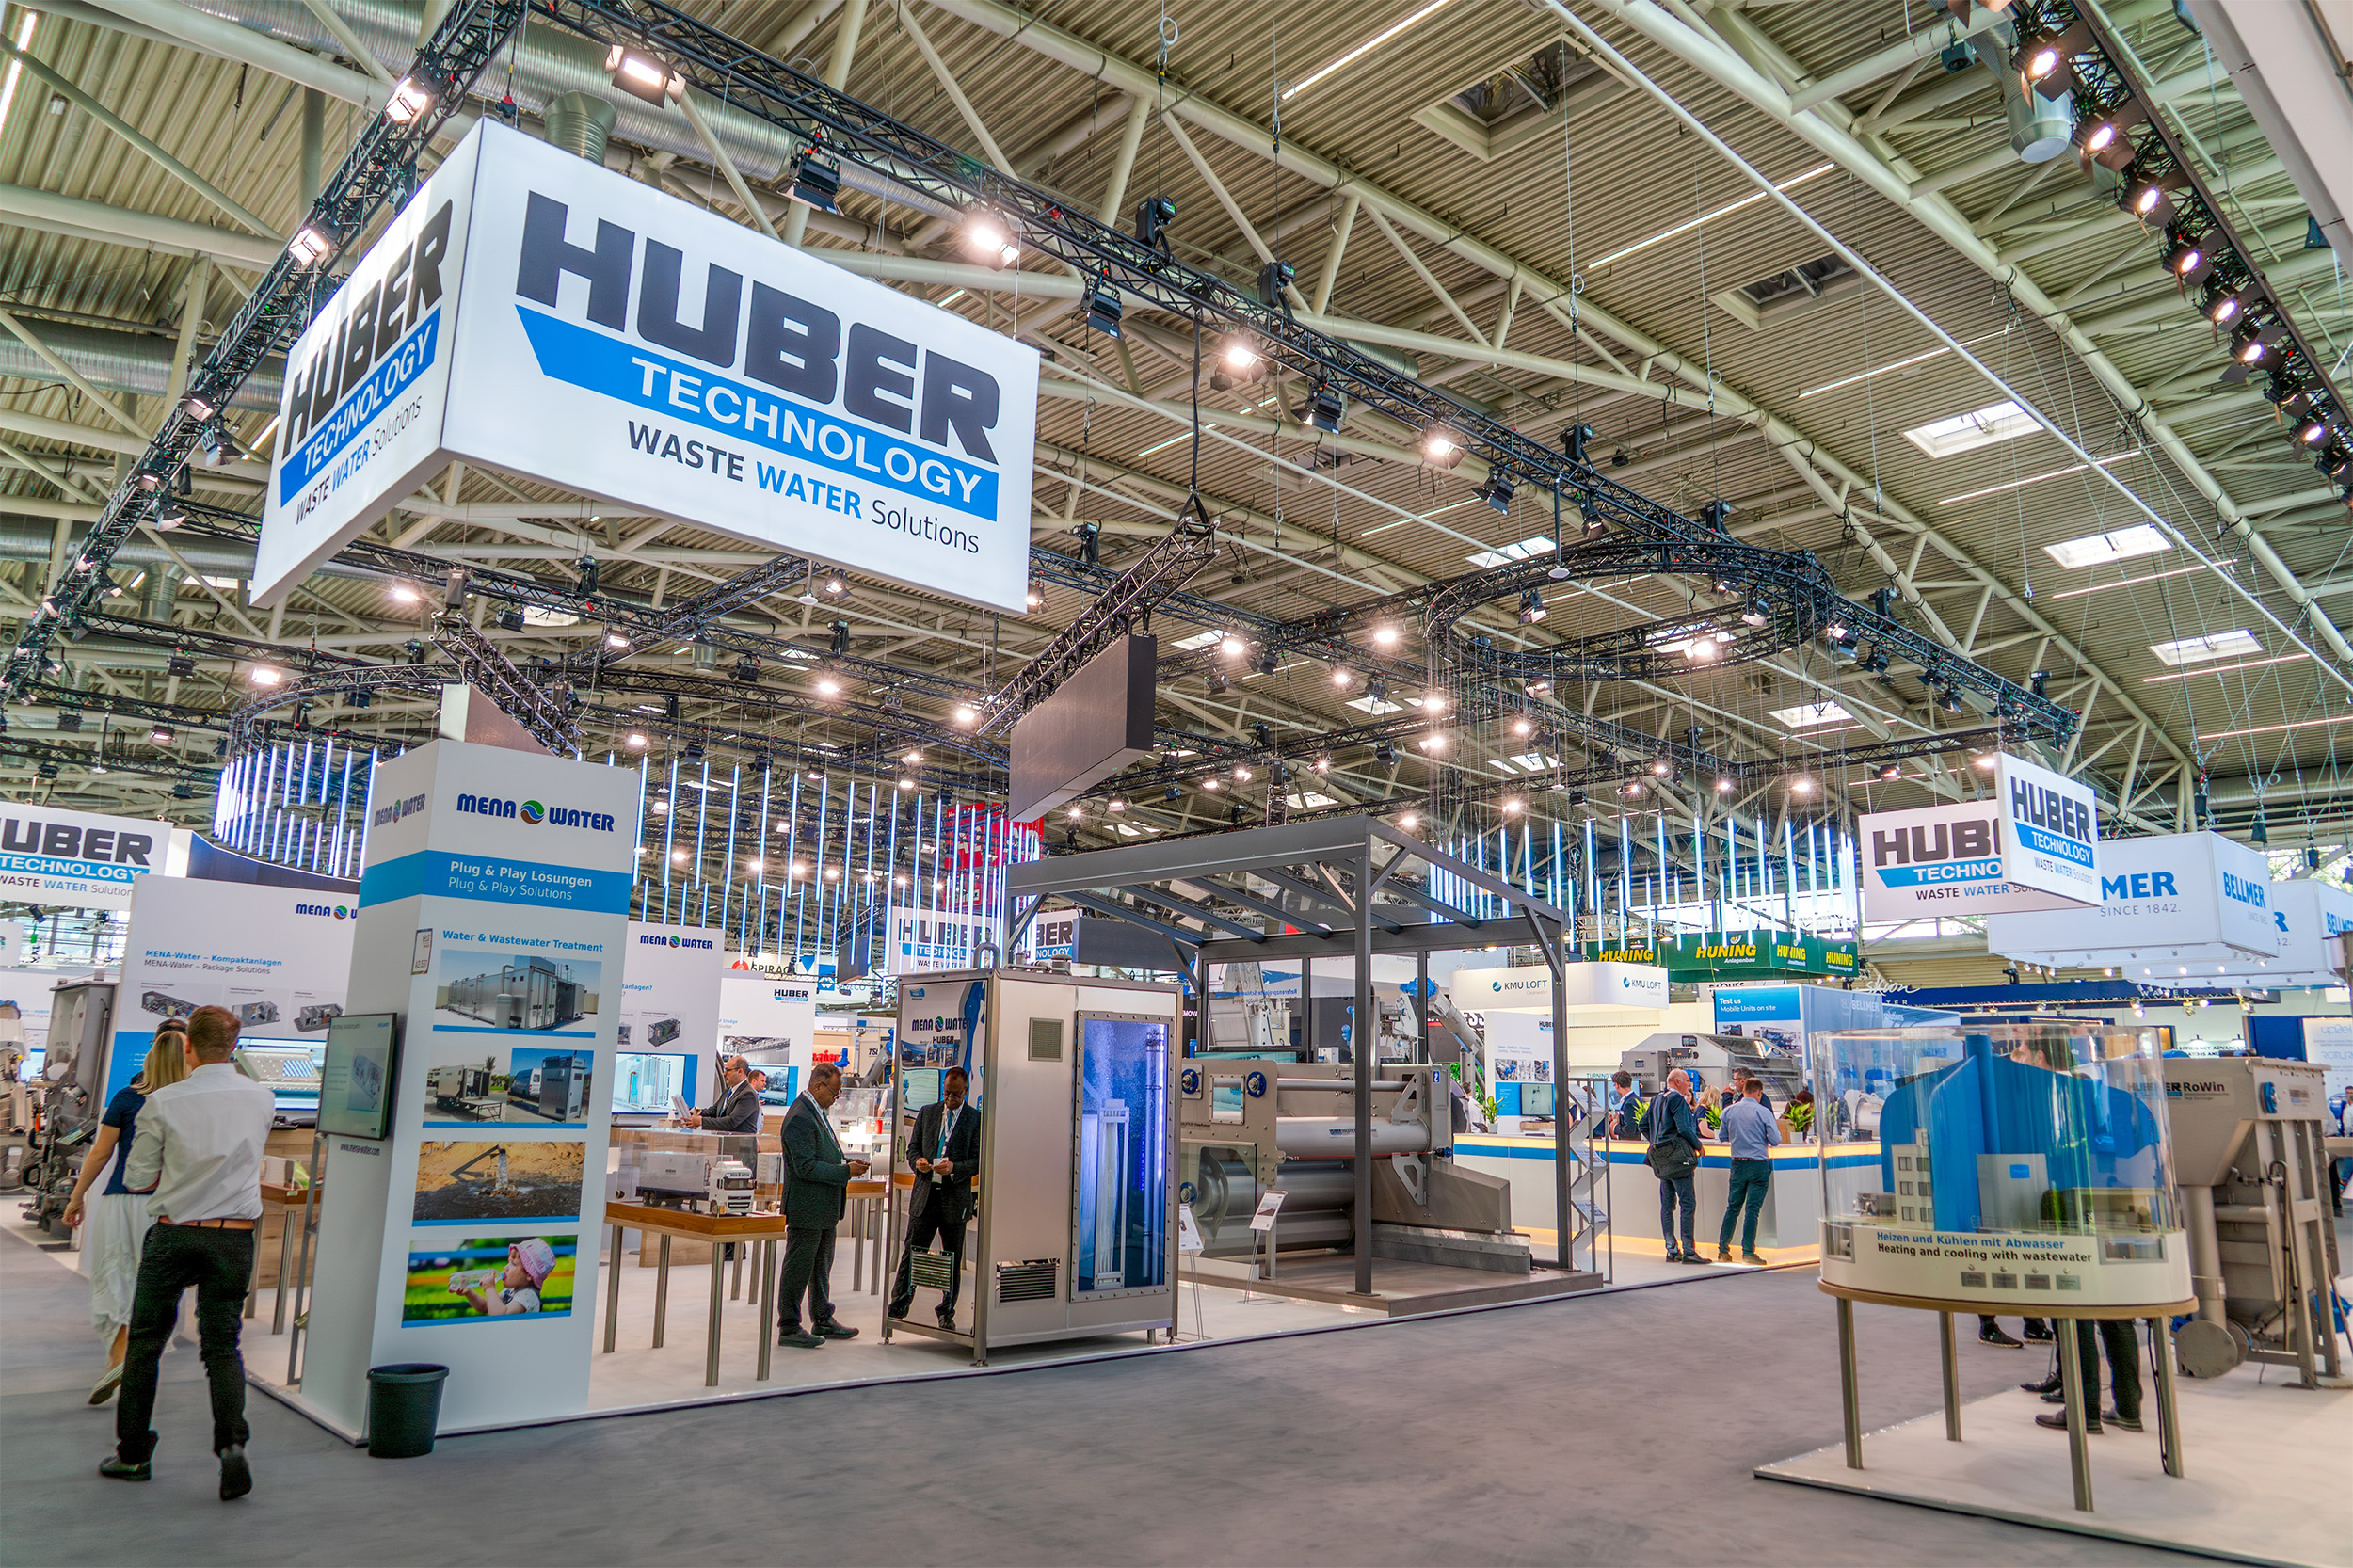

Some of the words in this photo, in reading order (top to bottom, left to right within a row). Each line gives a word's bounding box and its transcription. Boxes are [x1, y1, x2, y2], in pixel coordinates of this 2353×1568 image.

[282, 199, 453, 460] HUBER
[515, 190, 1000, 465] HUBER
[304, 325, 432, 476] TECHNOLOGY
[632, 357, 981, 502] TECHNOLOGY
[296, 480, 328, 525] WASTE
[332, 444, 369, 491] WATER
[372, 393, 422, 457] Solutions
[628, 420, 744, 482] WASTE
[757, 461, 862, 518] WATER
[871, 499, 979, 553] Solutions
[374, 807, 392, 827] MENA
[402, 793, 425, 817] WATER
[456, 793, 516, 819] MENA
[549, 807, 615, 832] WATER
[2010, 776, 2092, 844] HUBER
[0, 818, 152, 866] UBER
[1873, 819, 2002, 867] HUB
[2031, 830, 2091, 864] TECHNOLOGY
[0, 855, 142, 882] TECHNOLOGY
[450, 861, 481, 877] Plug
[485, 866, 495, 876] &
[500, 866, 527, 882] Play
[531, 871, 592, 888] Lösungen
[1913, 860, 2002, 882] TECHNO
[2034, 856, 2053, 872] WASTE
[2055, 862, 2073, 878] WATER
[44, 880, 87, 892] WATER
[91, 884, 133, 896] Solution
[449, 877, 474, 892] Plug
[478, 881, 488, 891] &
[492, 881, 517, 896] Play
[520, 884, 572, 901] Solutions
[1916, 888, 1960, 901] WASTE
[1964, 884, 2009, 897] WATER
[2223, 872, 2266, 909] BELLMER
[296, 903, 330, 917] MENA
[2101, 904, 2139, 917] SINCE
[2147, 903, 2182, 914] 1842.
[442, 930, 475, 942] Water
[478, 933, 486, 941] &
[489, 934, 551, 947] Wastewater
[552, 939, 603, 952] Treatment
[640, 935, 667, 946] MENA
[681, 938, 713, 950] WATER
[1036, 921, 1073, 947] BER
[145, 950, 201, 961] MENA-Water
[211, 954, 282, 967] Kompaktanlagen
[1599, 949, 1654, 962] HUNING
[1696, 944, 1756, 959] HUNING
[1777, 945, 1806, 961] HUNING
[1826, 952, 1853, 967] HUNING
[144, 959, 193, 969] MENA-Water
[202, 963, 234, 973] Package
[236, 965, 271, 975] Solutions
[775, 989, 808, 998] HUBER
[1504, 981, 1524, 990] KMU
[1526, 980, 1547, 989] LOFT
[1632, 980, 1646, 989] KMU
[1647, 981, 1661, 990] LOFT
[1851, 1000, 1881, 1013] BELLMER
[1883, 1010, 1905, 1022] solutions
[912, 1019, 933, 1031] MENA
[945, 1018, 972, 1031] WATER
[2184, 1081, 2225, 1092] RoWin
[1877, 1231, 1910, 1242] Heizen
[1913, 1234, 1932, 1244] und
[1937, 1235, 1978, 1247] Kühlen
[1981, 1238, 2001, 1247] mit
[2006, 1240, 2065, 1249] Abwasser
[1878, 1243, 1916, 1256] Heating
[1920, 1247, 1940, 1256] and
[1944, 1248, 1987, 1261] cooling
[1992, 1250, 2018, 1260] with
[2023, 1252, 2092, 1262] wastewater
